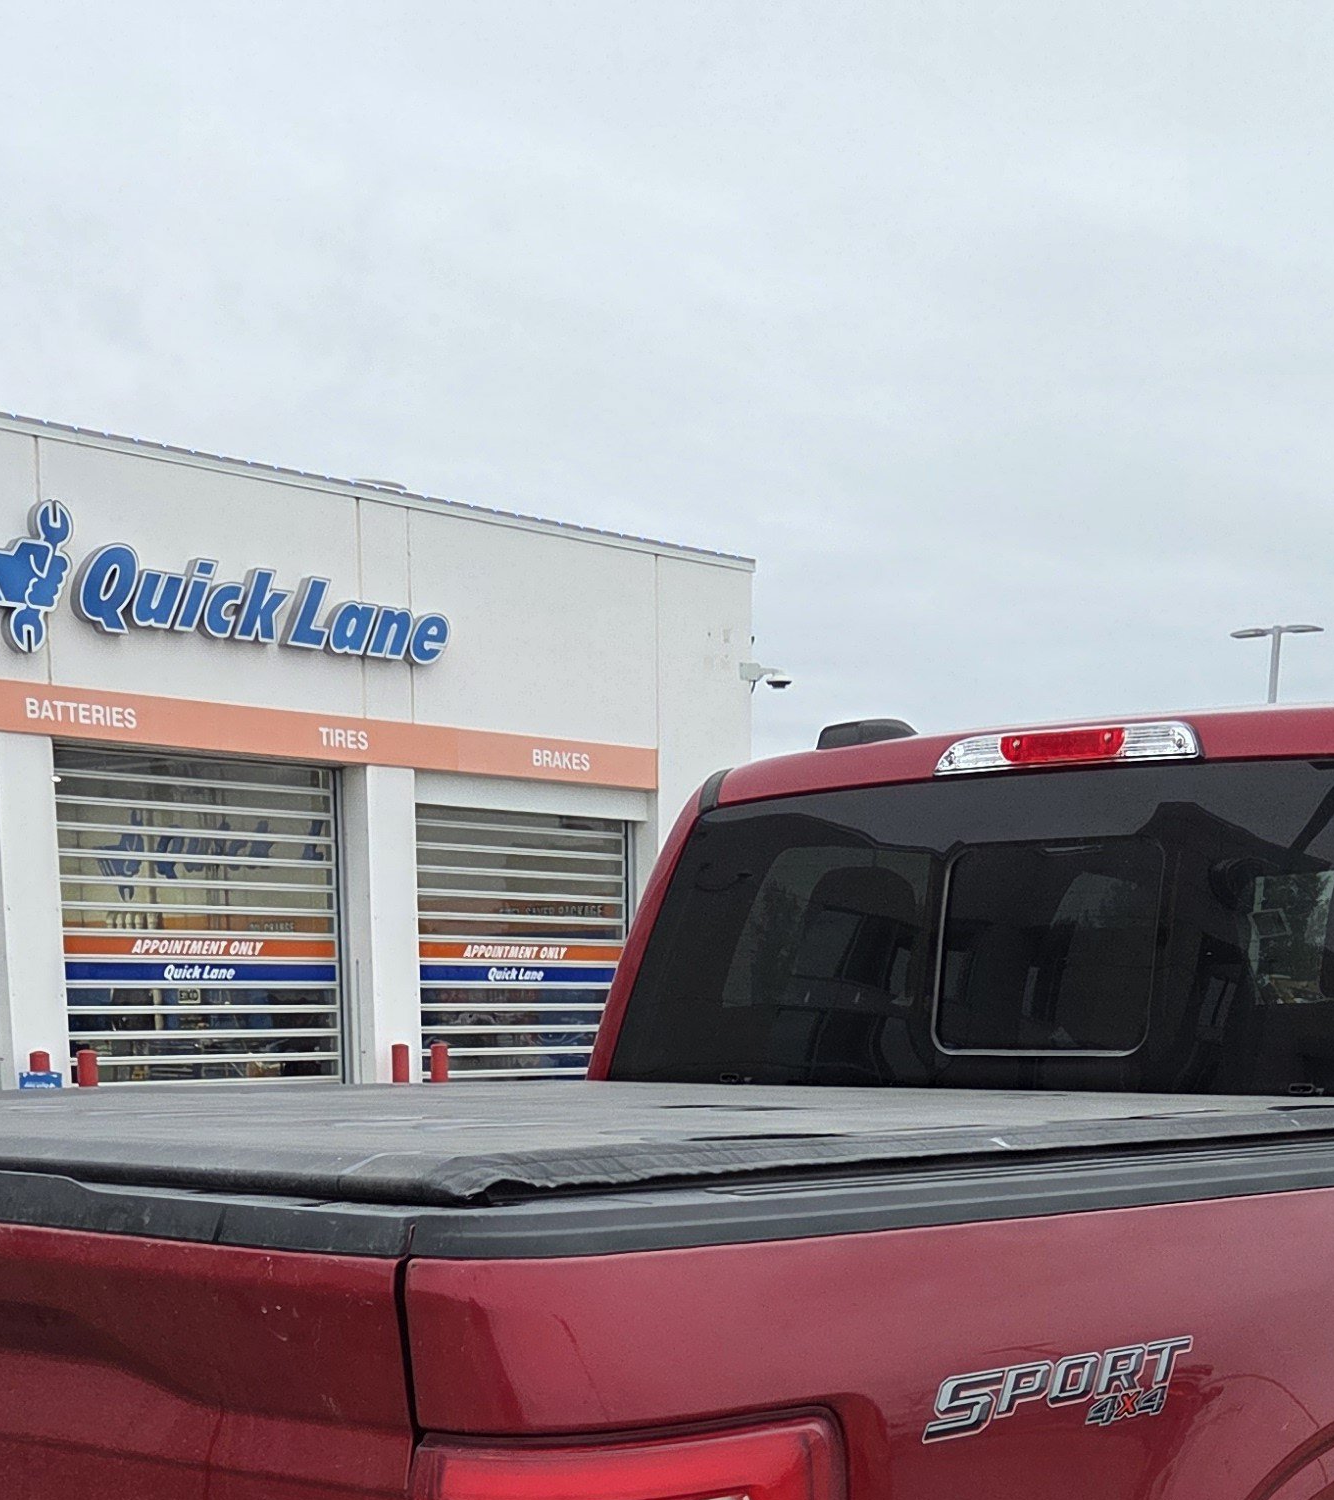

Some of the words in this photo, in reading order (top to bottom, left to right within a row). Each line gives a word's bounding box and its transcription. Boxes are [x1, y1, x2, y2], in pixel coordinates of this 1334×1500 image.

[75, 542, 291, 642] Quick
[284, 576, 451, 665] Lane
[25, 697, 137, 729] BATTERIES
[318, 727, 369, 750] TIRES
[532, 748, 590, 772] BRAKES
[132, 939, 228, 955] APPOINTMENT
[229, 941, 264, 956] ONLY
[463, 945, 539, 959] APPOINTMENT
[539, 947, 568, 960] ONLY
[163, 964, 203, 980] Quick
[202, 965, 236, 980] Lane
[487, 967, 518, 982] Quick
[518, 968, 544, 981] Lane
[922, 1335, 1194, 1444] SPORT
